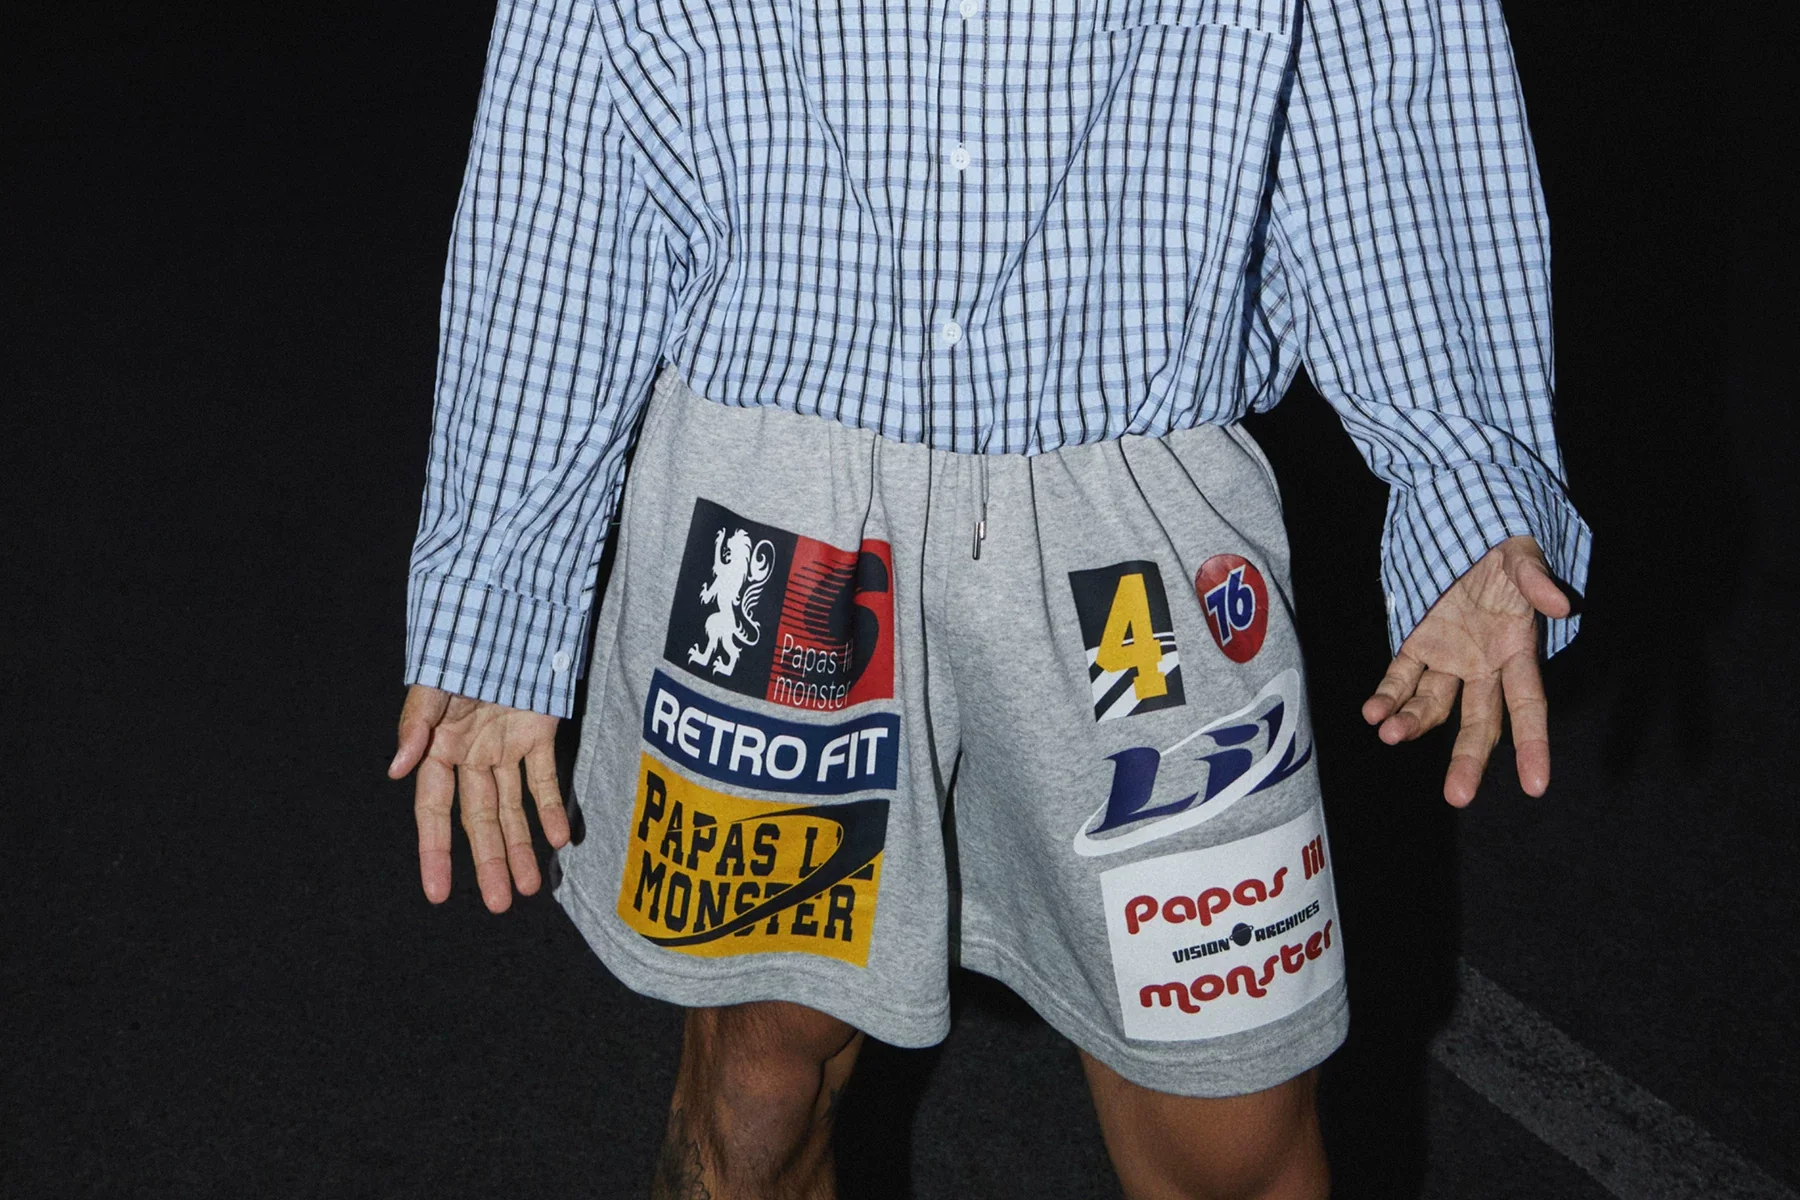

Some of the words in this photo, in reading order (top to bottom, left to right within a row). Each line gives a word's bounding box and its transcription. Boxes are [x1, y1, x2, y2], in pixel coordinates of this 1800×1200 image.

[1095, 572, 1168, 700] 4
[1204, 564, 1256, 646] 76
[773, 675, 851, 709] monster
[780, 632, 838, 678] Papas
[651, 687, 807, 780] RETRO
[816, 727, 888, 782] FIT
[637, 769, 780, 877] PAPAS
[633, 849, 856, 942] MONSTER
[1124, 866, 1289, 935] papas
[1301, 834, 1325, 880] lil
[1172, 937, 1231, 964] VISION
[1254, 899, 1321, 943] ARCHIVES
[1138, 918, 1333, 1014] monster
